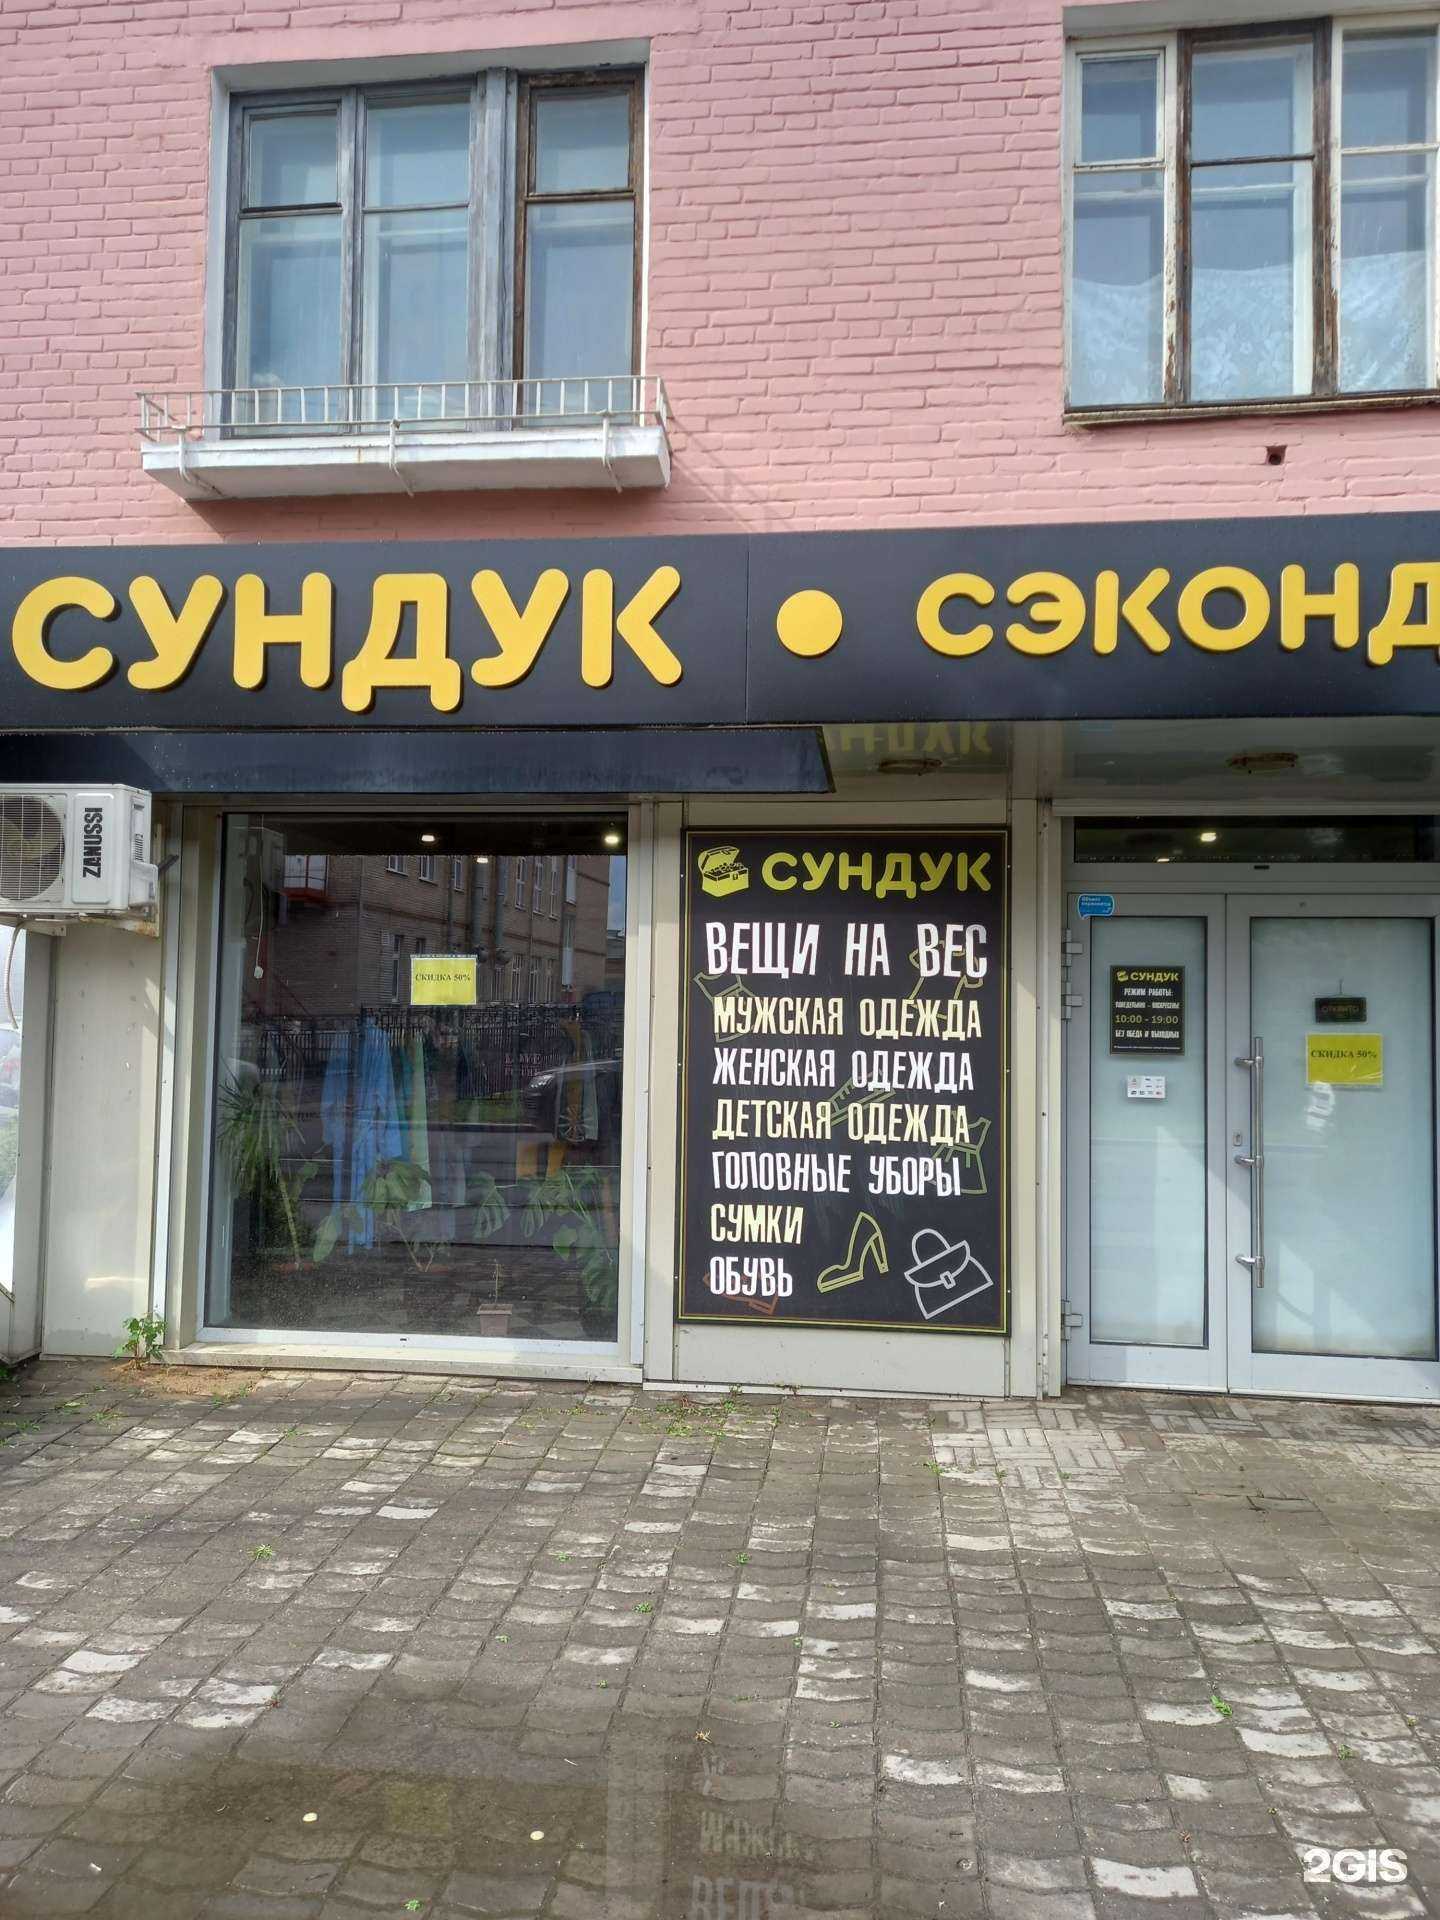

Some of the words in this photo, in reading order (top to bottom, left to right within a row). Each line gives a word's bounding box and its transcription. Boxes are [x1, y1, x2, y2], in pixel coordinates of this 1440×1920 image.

[12, 565, 683, 712] СУНДУК
[916, 561, 1440, 667] СЭКОНД
[82, 807, 103, 878] ZANUSSI
[761, 851, 992, 899] СУНДУК
[705, 921, 820, 979] ВЕЩИ
[844, 922, 890, 977] НА
[916, 922, 988, 979] ВЕС
[415, 973, 452, 982] СКИДКА
[454, 973, 471, 982] 50%
[1130, 971, 1179, 982] СУНДУК
[713, 996, 844, 1036] МУЖСКАЯ
[859, 998, 982, 1041] ОДЕЖДА
[1115, 1014, 1143, 1024] 10:00
[1151, 1015, 1179, 1025] 19:00
[712, 1047, 836, 1088] ЖЕНСКАЯ
[851, 1050, 974, 1094] ОДЕЖДА
[1311, 1049, 1354, 1059] СКИДКА
[1356, 1049, 1377, 1059] 50%
[712, 1098, 832, 1141] ДЕТСКАЯ
[848, 1102, 971, 1147] ОДЕЖДА
[711, 1151, 852, 1194] ГОЛОВНЫЕ
[868, 1156, 961, 1197] УБОРЫ
[709, 1203, 804, 1245] СУМКИ
[709, 1256, 793, 1298] ОБУВЬ
